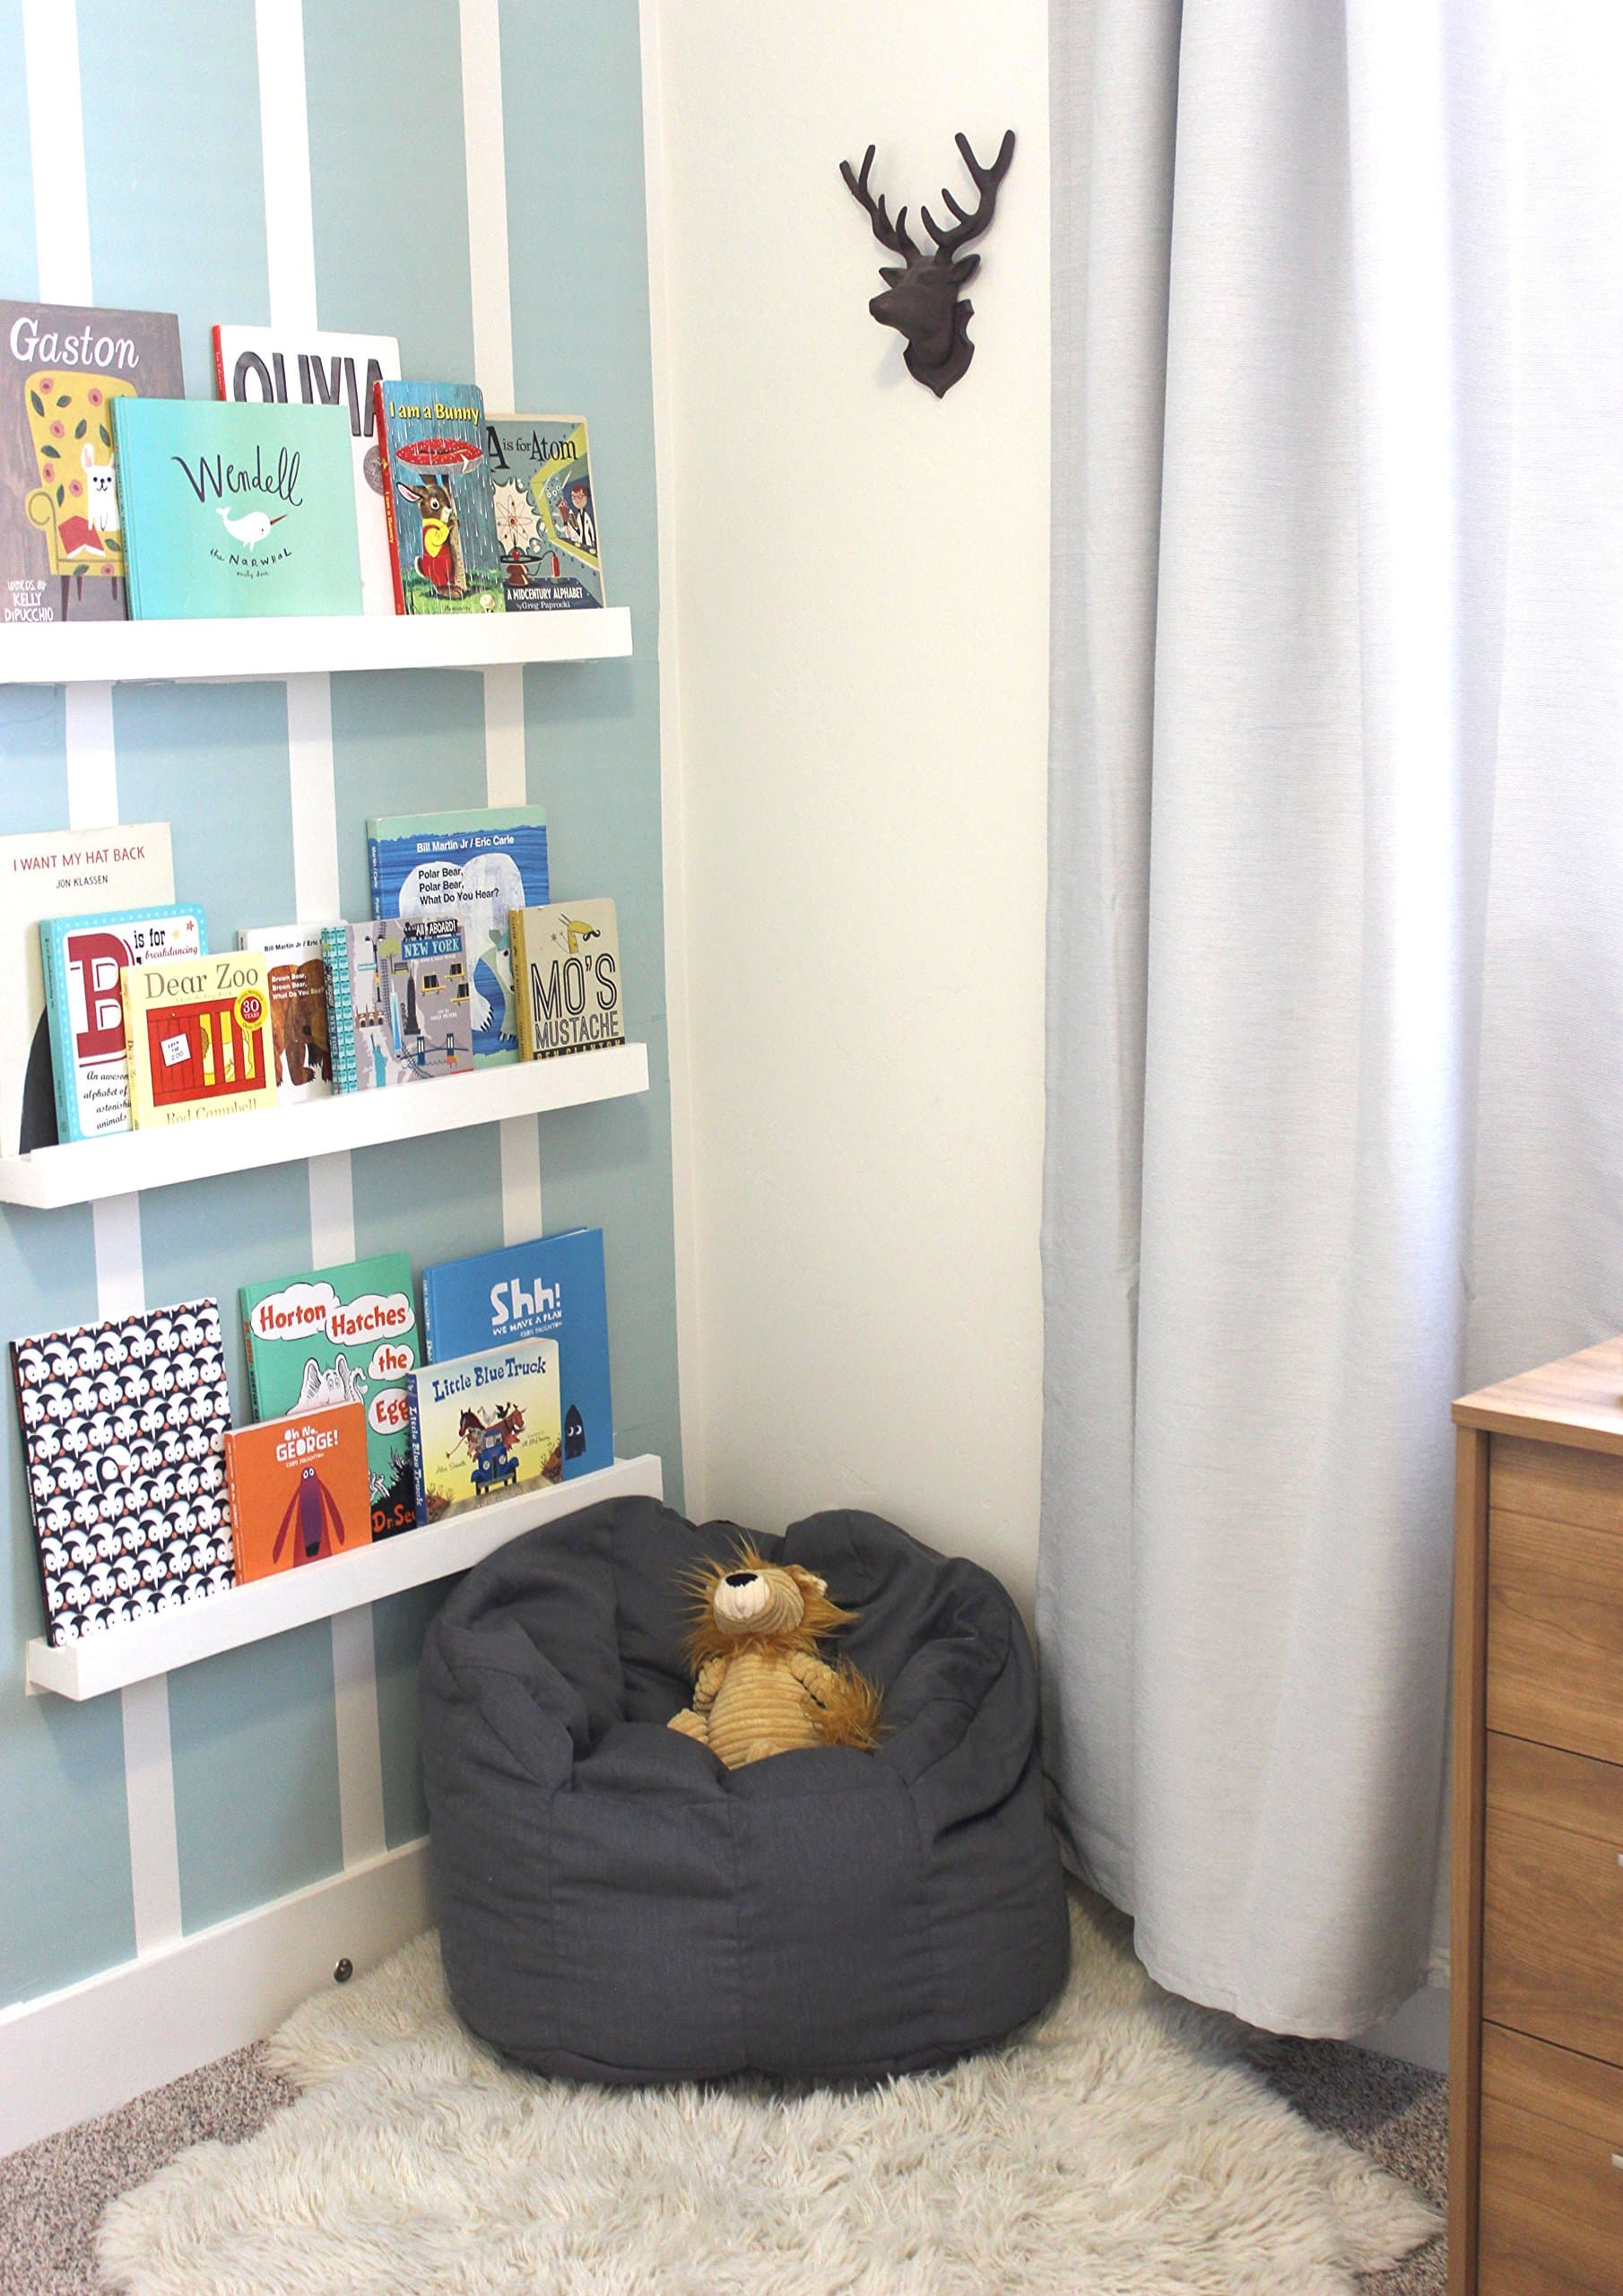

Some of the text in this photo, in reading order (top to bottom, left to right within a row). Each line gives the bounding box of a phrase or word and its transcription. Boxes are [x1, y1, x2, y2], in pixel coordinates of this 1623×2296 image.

[10, 317, 139, 370] Gaston
[389, 401, 479, 427] I am a Bunny
[486, 426, 578, 470] A is for Atom
[171, 445, 304, 506] Wendell
[13, 592, 42, 606] KELLY
[507, 587, 583, 600] A MIDCENTURY ALPHABET
[522, 602, 539, 610] Greg
[416, 842, 430, 853] Bill
[432, 840, 458, 851] Martin
[460, 839, 469, 848] Jr
[474, 837, 491, 847] Eric
[493, 835, 515, 845] Carle
[13, 846, 145, 871] I WANT MY HAT BACK
[56, 874, 108, 889] JON KLASSEN
[419, 867, 464, 880] Polar Bear,
[419, 880, 464, 892] Polar Bear,
[420, 888, 499, 905] What Do You Hear?
[134, 929, 144, 949] is
[149, 927, 166, 947] for
[404, 942, 429, 959] NEW
[432, 937, 460, 953] YORK
[143, 972, 207, 999] Dear
[216, 963, 258, 989] Zoo
[272, 984, 291, 992] Brown
[531, 952, 618, 1022] MO'S
[243, 998, 260, 1013] 30
[273, 992, 288, 1000] What
[535, 1010, 620, 1049] MUSTACHE
[87, 1071, 98, 1081] An
[83, 1085, 128, 1100] alphabet of
[97, 1112, 127, 1130] animals
[490, 1277, 561, 1326] Shh!
[260, 1305, 407, 1337] Horton Hatches
[492, 1310, 562, 1335] WE HAVE A PLAN
[378, 1348, 407, 1372] the
[432, 1356, 546, 1403] Little Blue Truck
[375, 1396, 409, 1425] Egg
[284, 1428, 299, 1441] Oh
[276, 1430, 338, 1462] GEORGE!
[409, 1406, 423, 1506] Little Blue Truck
